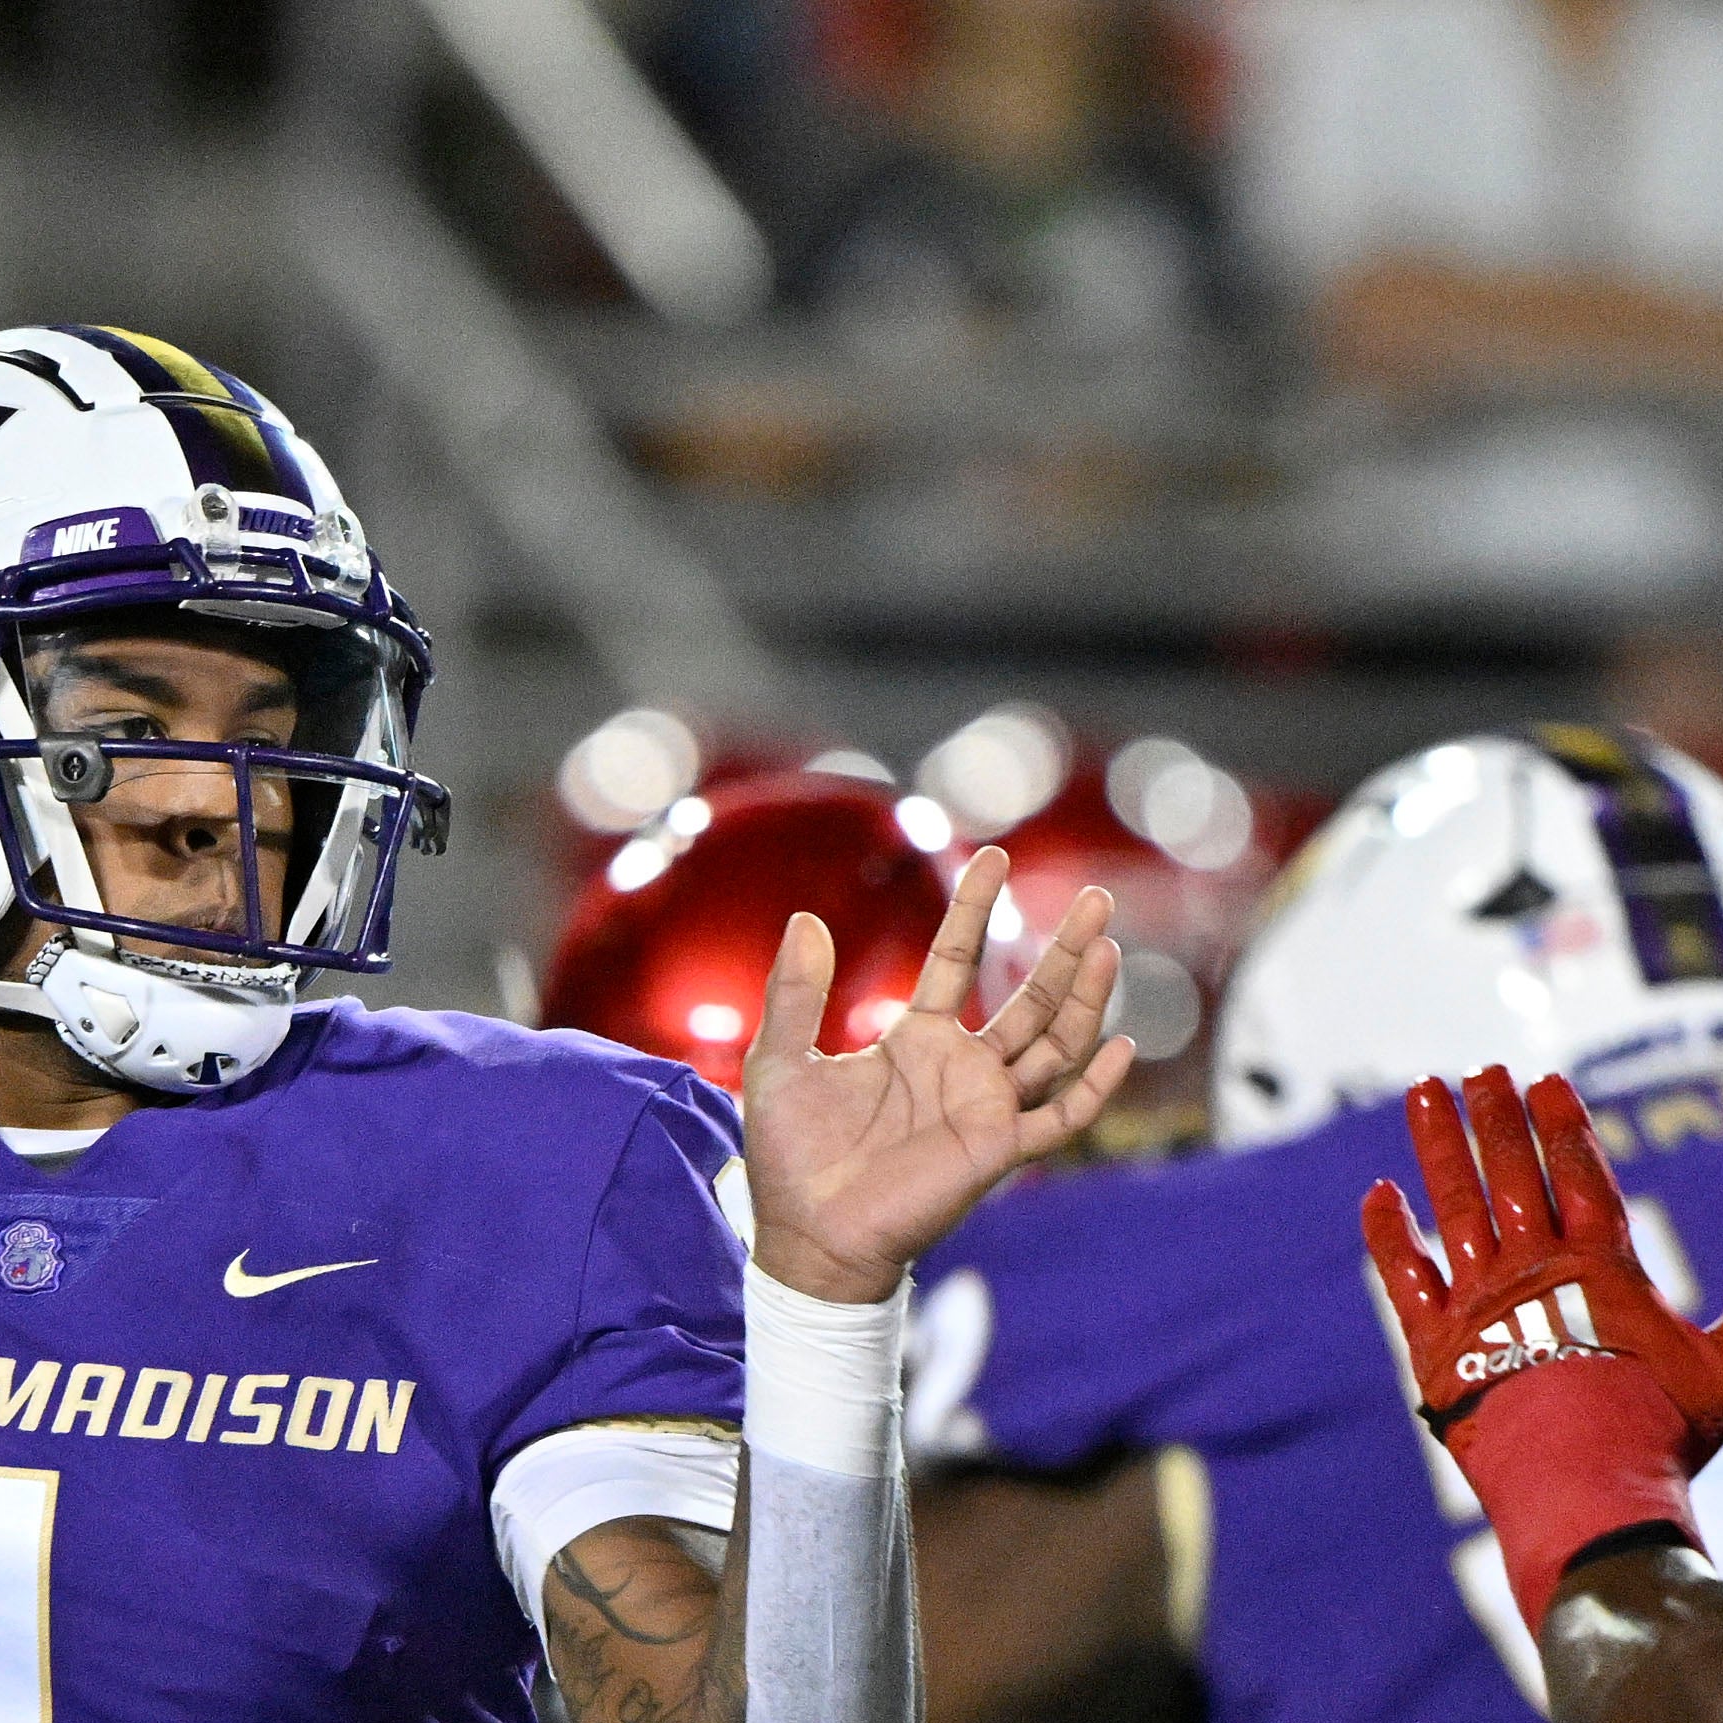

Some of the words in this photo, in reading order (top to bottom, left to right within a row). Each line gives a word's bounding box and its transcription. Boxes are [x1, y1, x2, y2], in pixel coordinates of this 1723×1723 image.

[51, 516, 121, 558] NIKE
[238, 507, 315, 542] DUKES
[1455, 1340, 1616, 1382] adid
